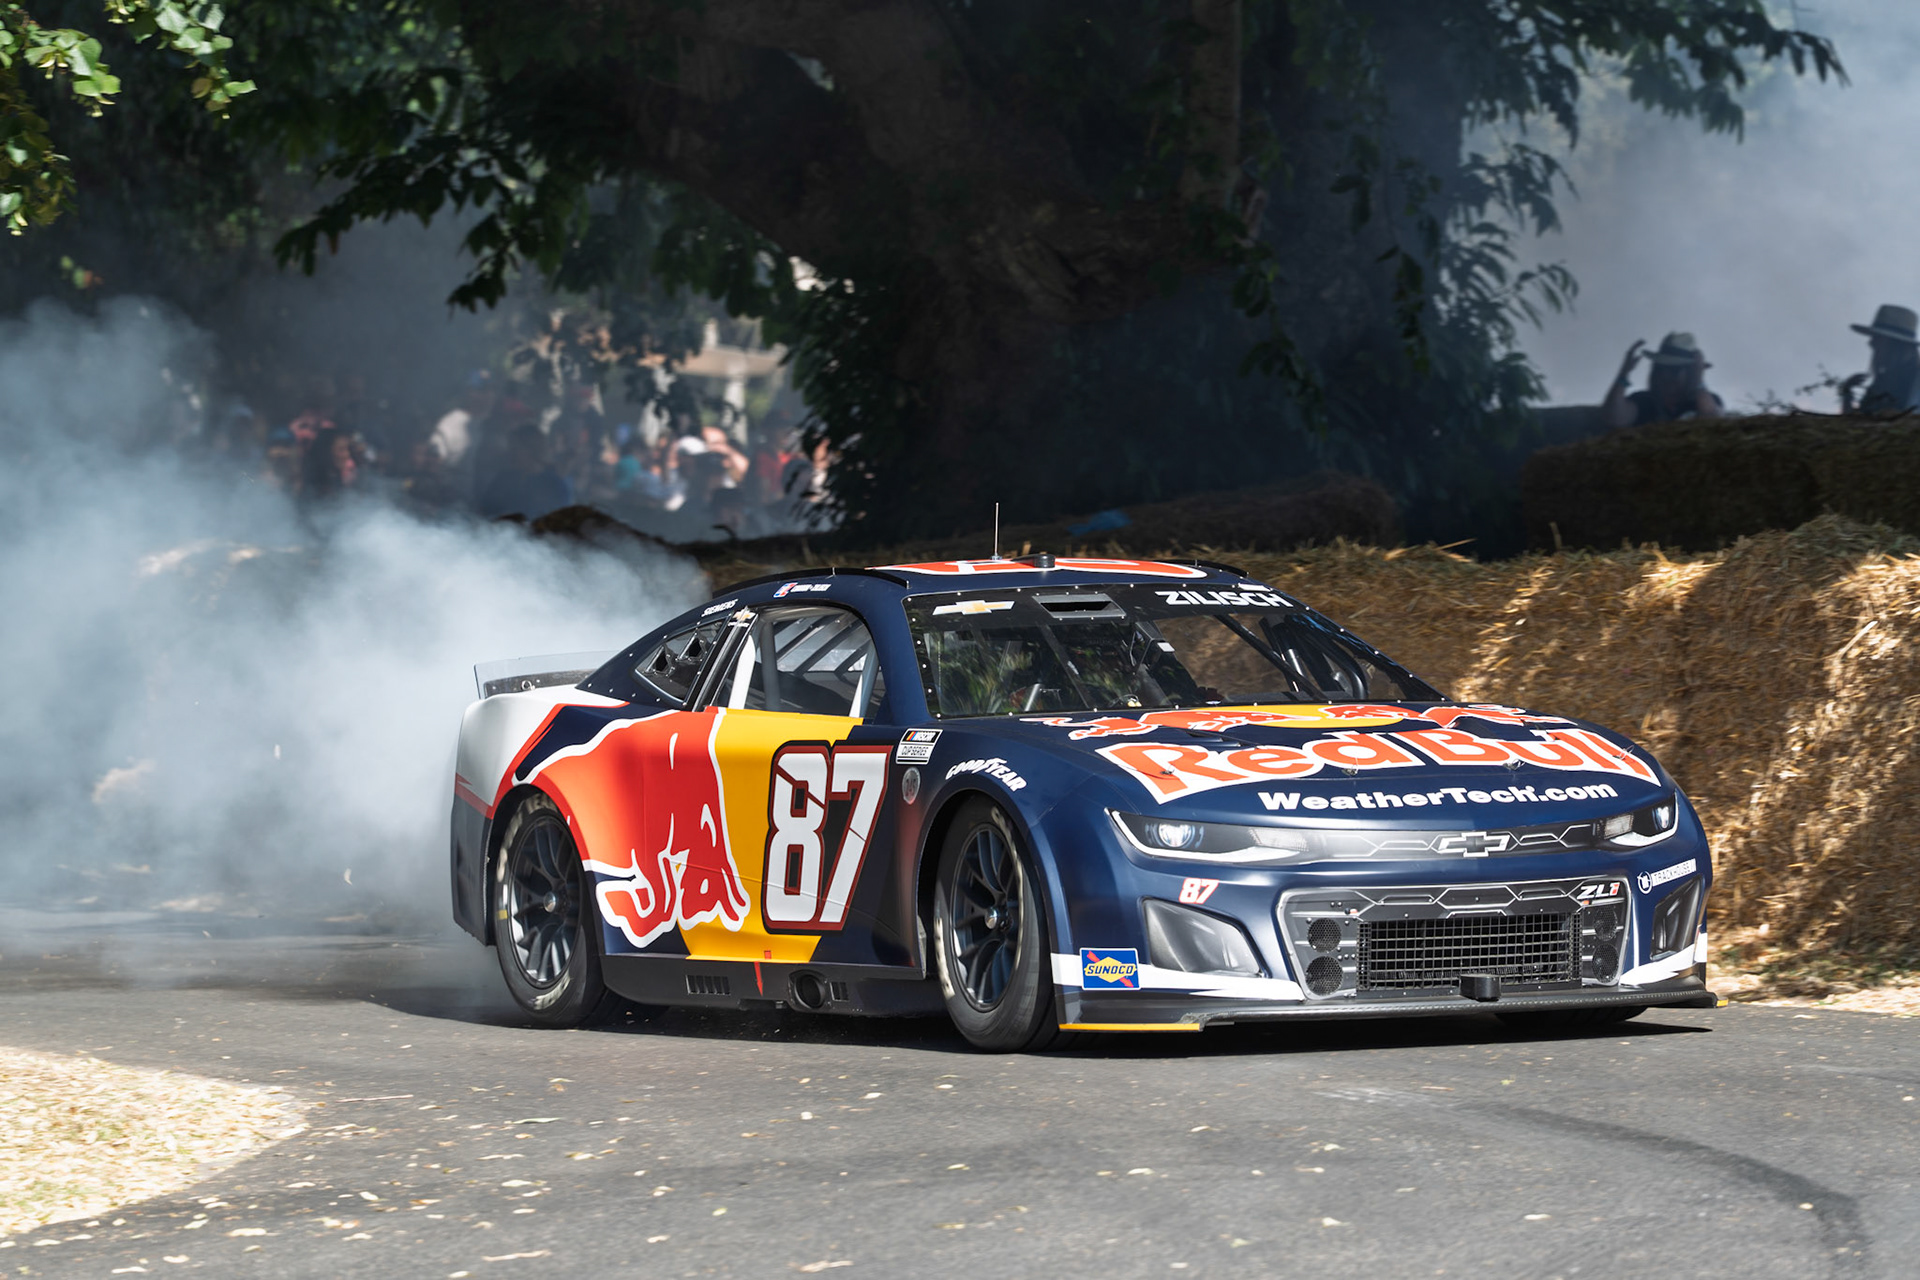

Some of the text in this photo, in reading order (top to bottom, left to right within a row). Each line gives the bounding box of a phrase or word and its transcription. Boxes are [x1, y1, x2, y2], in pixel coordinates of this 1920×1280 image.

[1154, 590, 1295, 607] ZILISCH
[945, 757, 1027, 792] GOODYEAR
[1094, 728, 1662, 805] Red Bull
[764, 745, 894, 930] 87
[1179, 877, 1219, 904] 87
[1576, 882, 1620, 900] ZL1
[1086, 965, 1134, 975] SUNOCO
